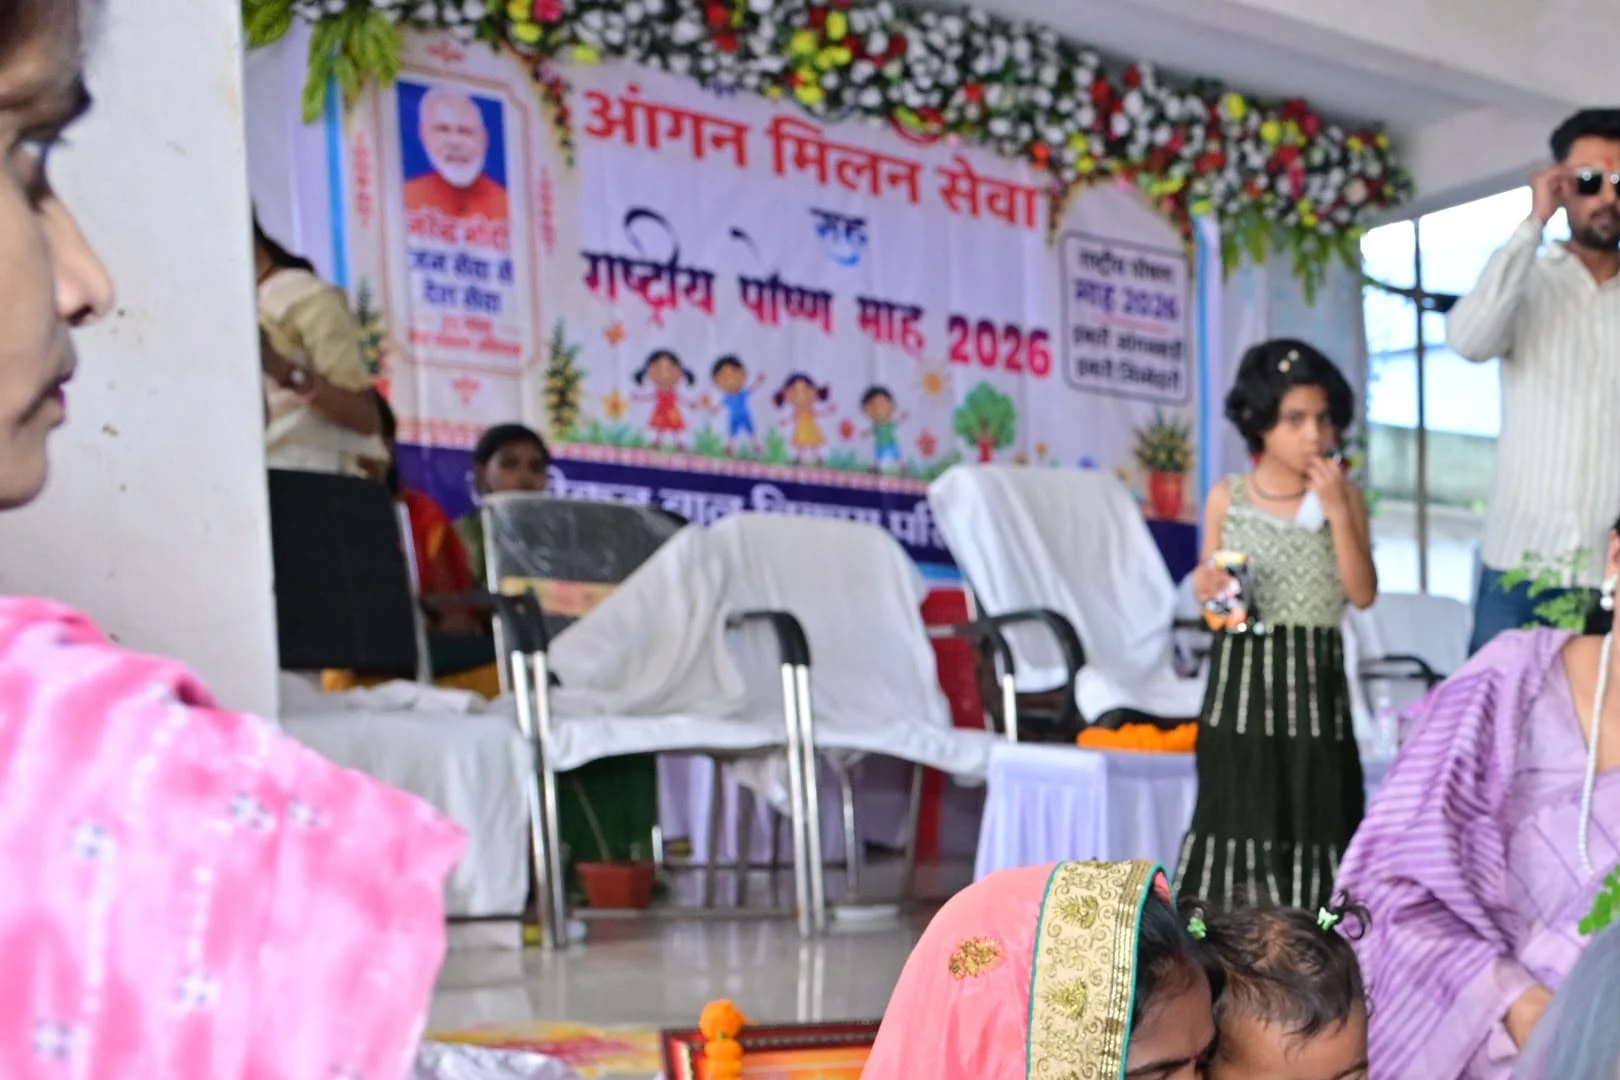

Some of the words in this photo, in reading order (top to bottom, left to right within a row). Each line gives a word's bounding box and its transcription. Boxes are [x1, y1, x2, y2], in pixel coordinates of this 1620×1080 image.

[582, 83, 749, 167] आंगन
[768, 113, 923, 204] मिलन
[937, 154, 1038, 229] सेवा
[856, 294, 926, 359] माह
[947, 314, 1054, 379] 2026
